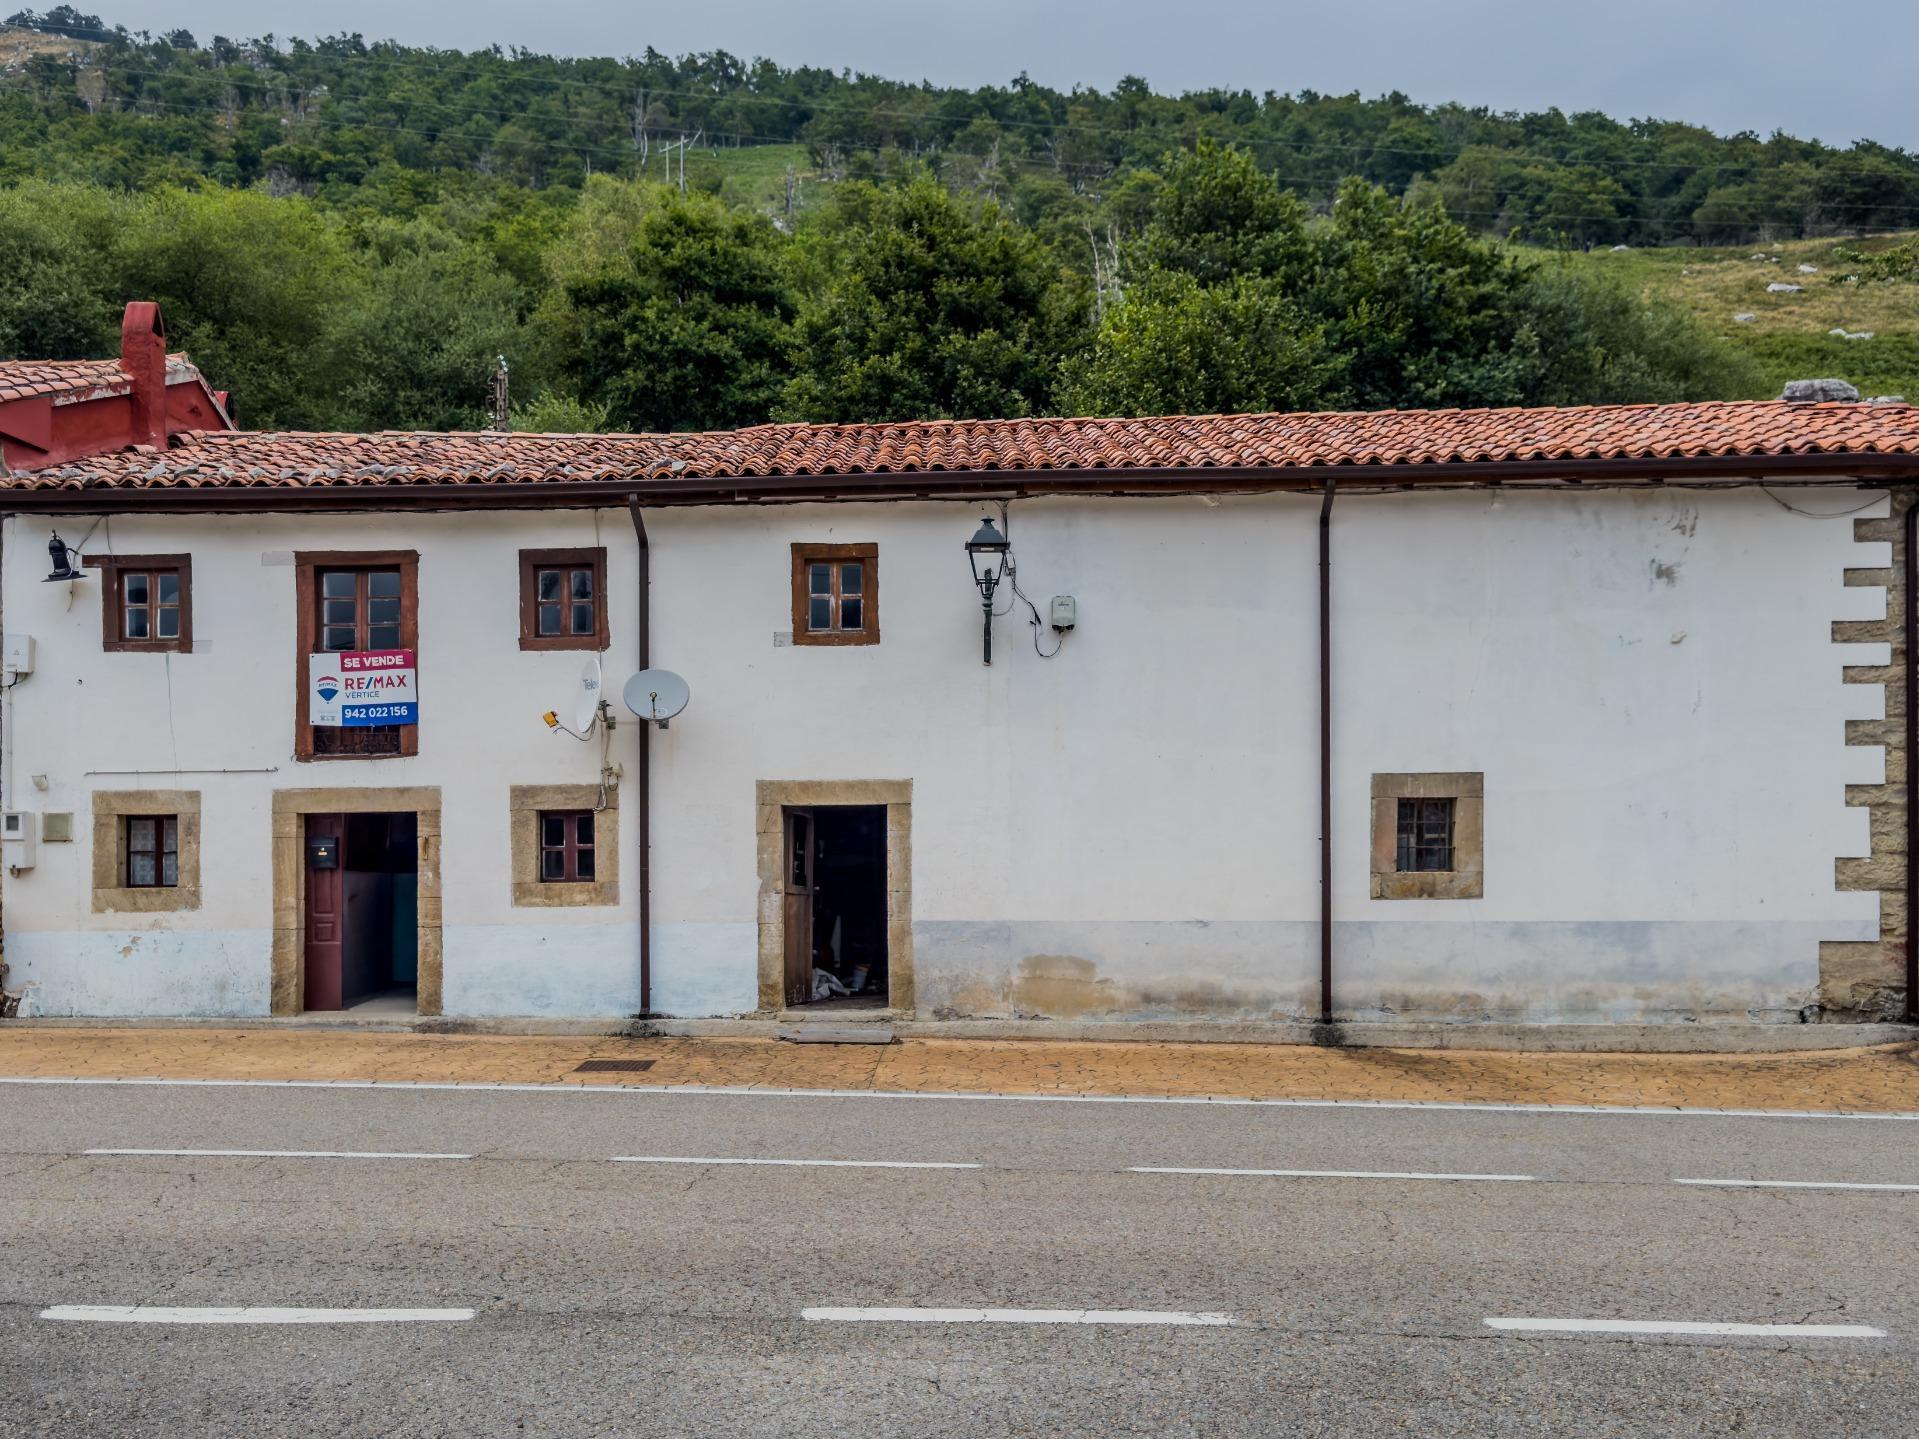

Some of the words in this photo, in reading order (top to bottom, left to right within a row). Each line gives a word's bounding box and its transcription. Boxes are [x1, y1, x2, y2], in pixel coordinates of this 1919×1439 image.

[343, 657, 361, 668] SE
[362, 655, 404, 667] VENDE
[344, 675, 407, 690] RE/MAX
[344, 708, 367, 718] 942
[368, 707, 388, 717] 022
[389, 705, 408, 717] 156
